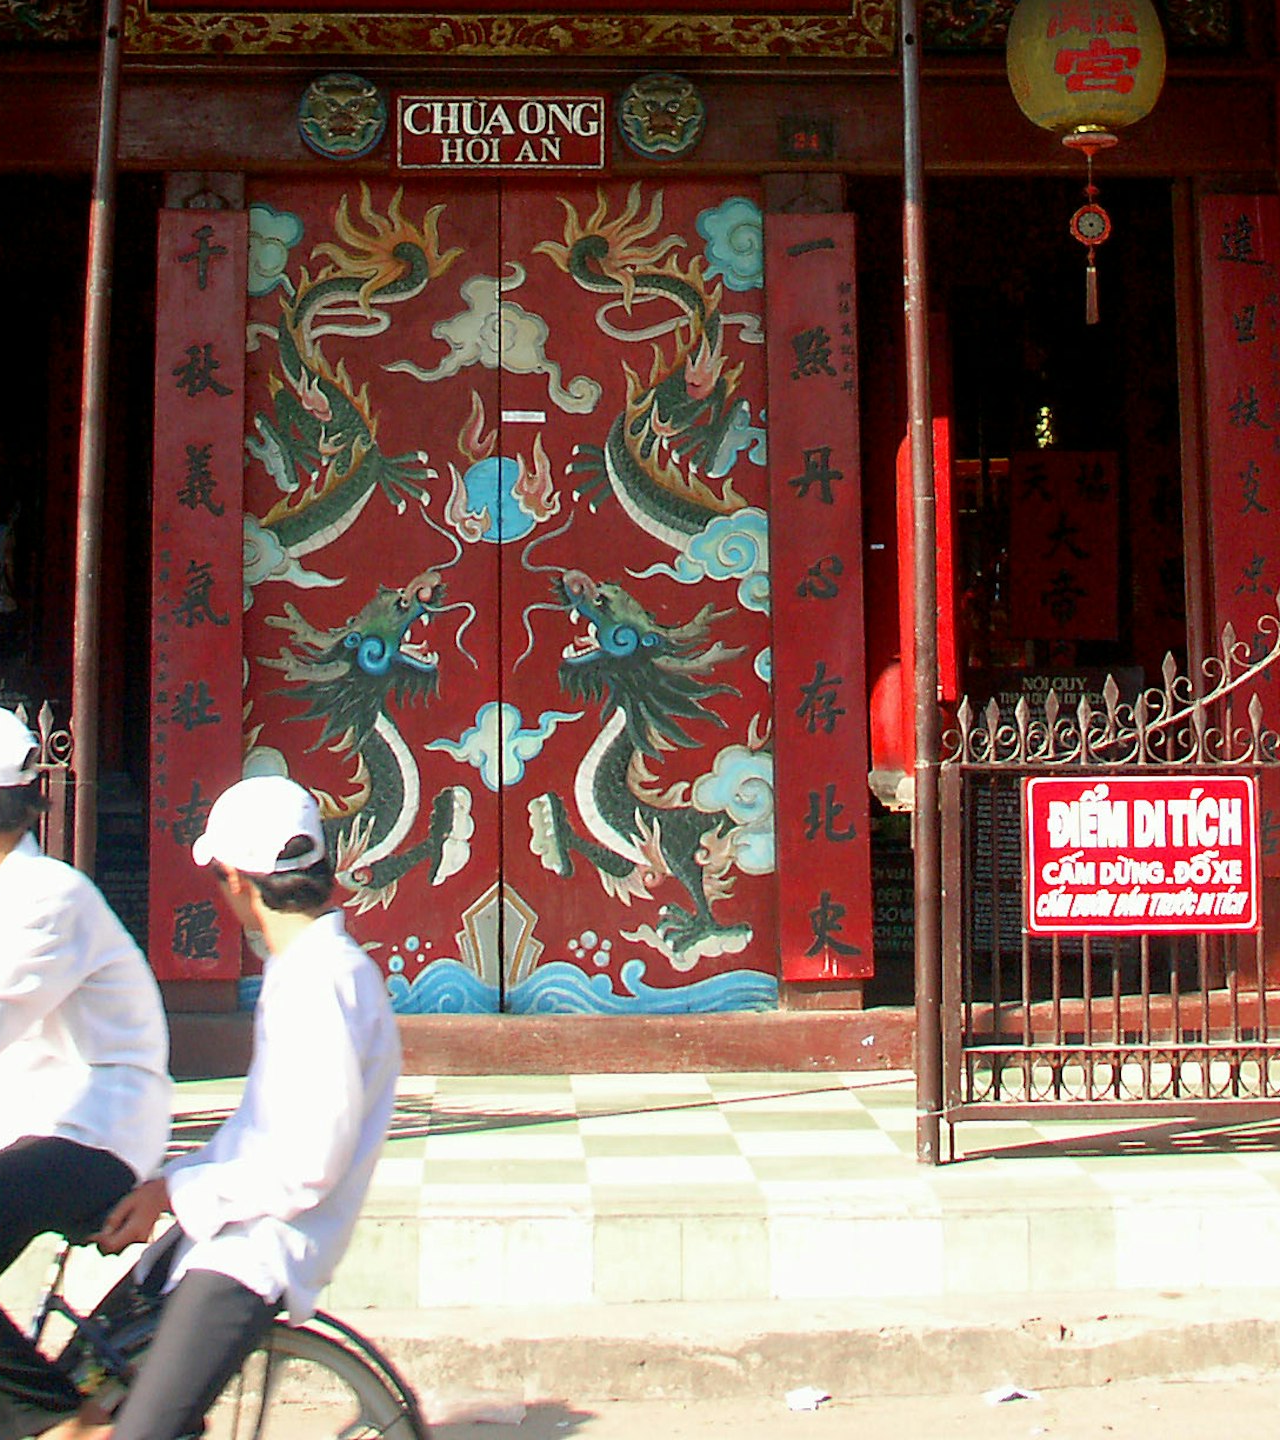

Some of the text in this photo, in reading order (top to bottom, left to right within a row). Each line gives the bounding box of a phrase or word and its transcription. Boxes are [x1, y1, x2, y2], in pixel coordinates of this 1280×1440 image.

[515, 137, 561, 162] AN
[1046, 783, 1243, 849] ĐIỂM DI TÍCH
[1041, 850, 1096, 885] CẤM
[1210, 859, 1243, 885] XE
